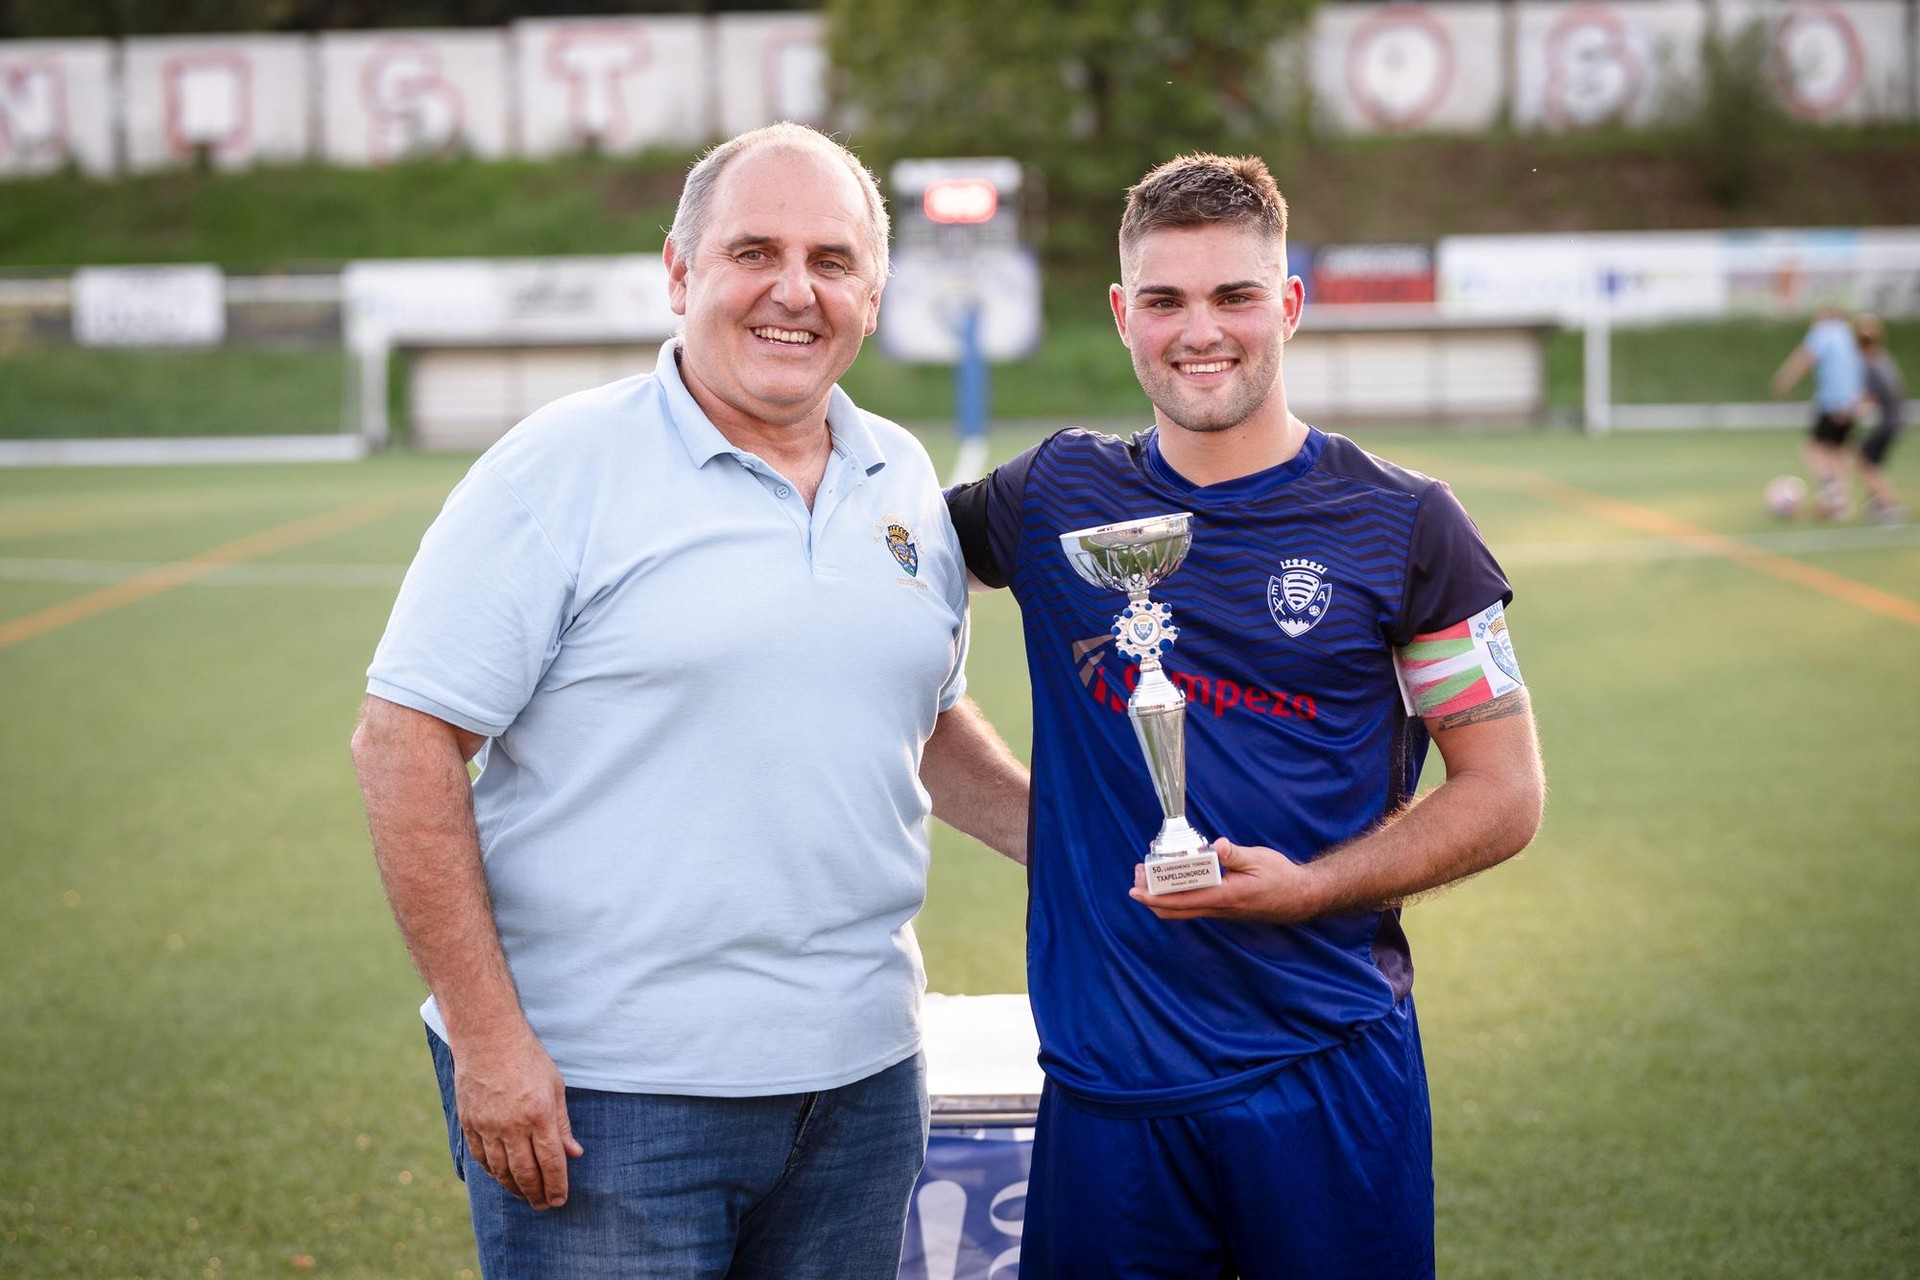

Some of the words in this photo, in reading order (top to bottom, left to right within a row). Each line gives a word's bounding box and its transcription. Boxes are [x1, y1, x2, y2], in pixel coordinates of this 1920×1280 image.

[1271, 584, 1280, 596] E
[1316, 590, 1327, 602] A
[1124, 664, 1317, 721] Cmpezo
